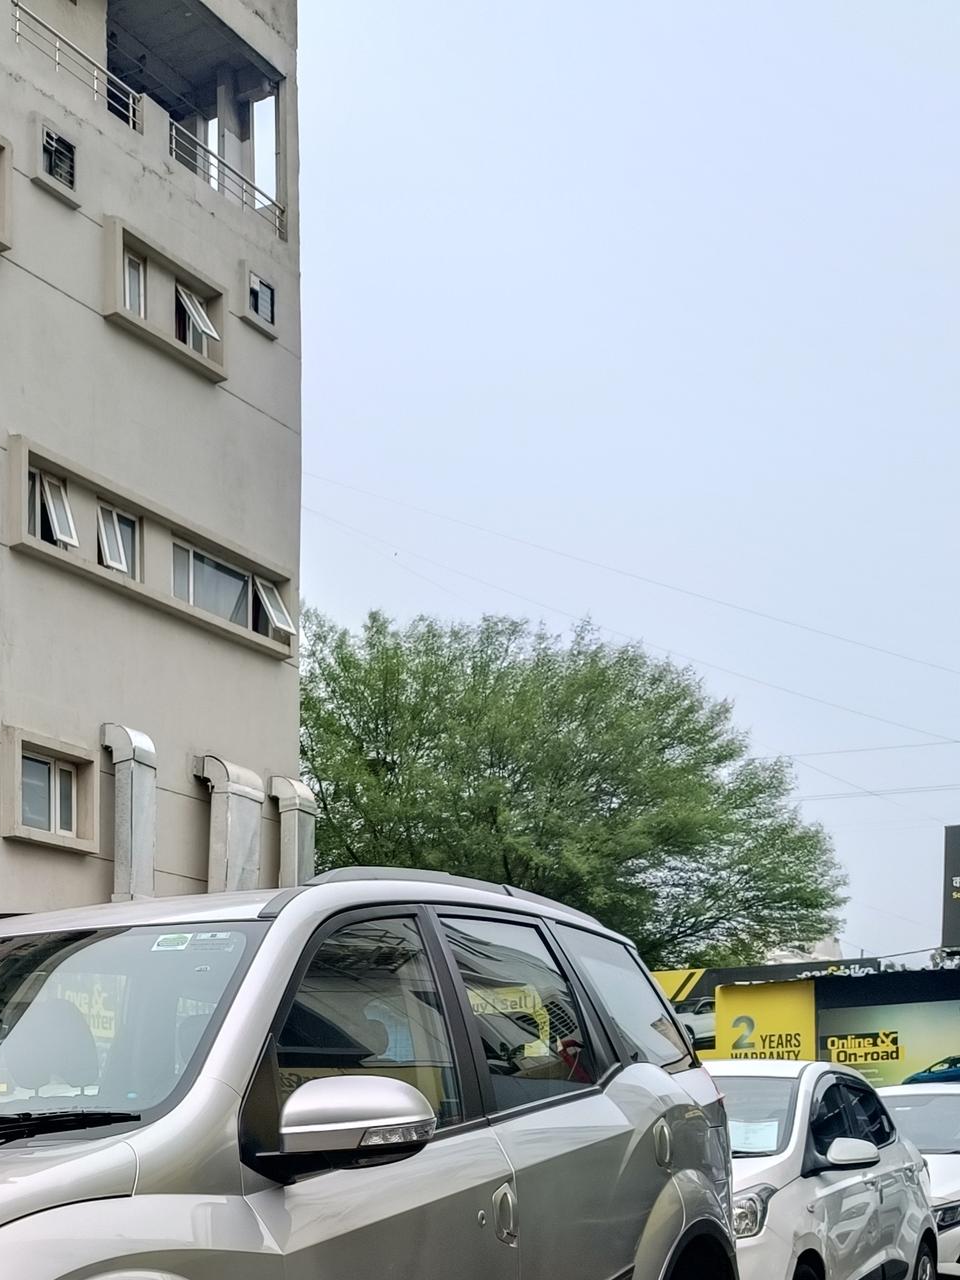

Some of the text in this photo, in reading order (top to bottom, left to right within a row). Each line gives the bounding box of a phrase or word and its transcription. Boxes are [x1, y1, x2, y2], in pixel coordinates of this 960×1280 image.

[731, 1015, 801, 1049] 2 YEARS
[827, 1031, 898, 1050] Online &
[836, 1046, 900, 1063] On-road
